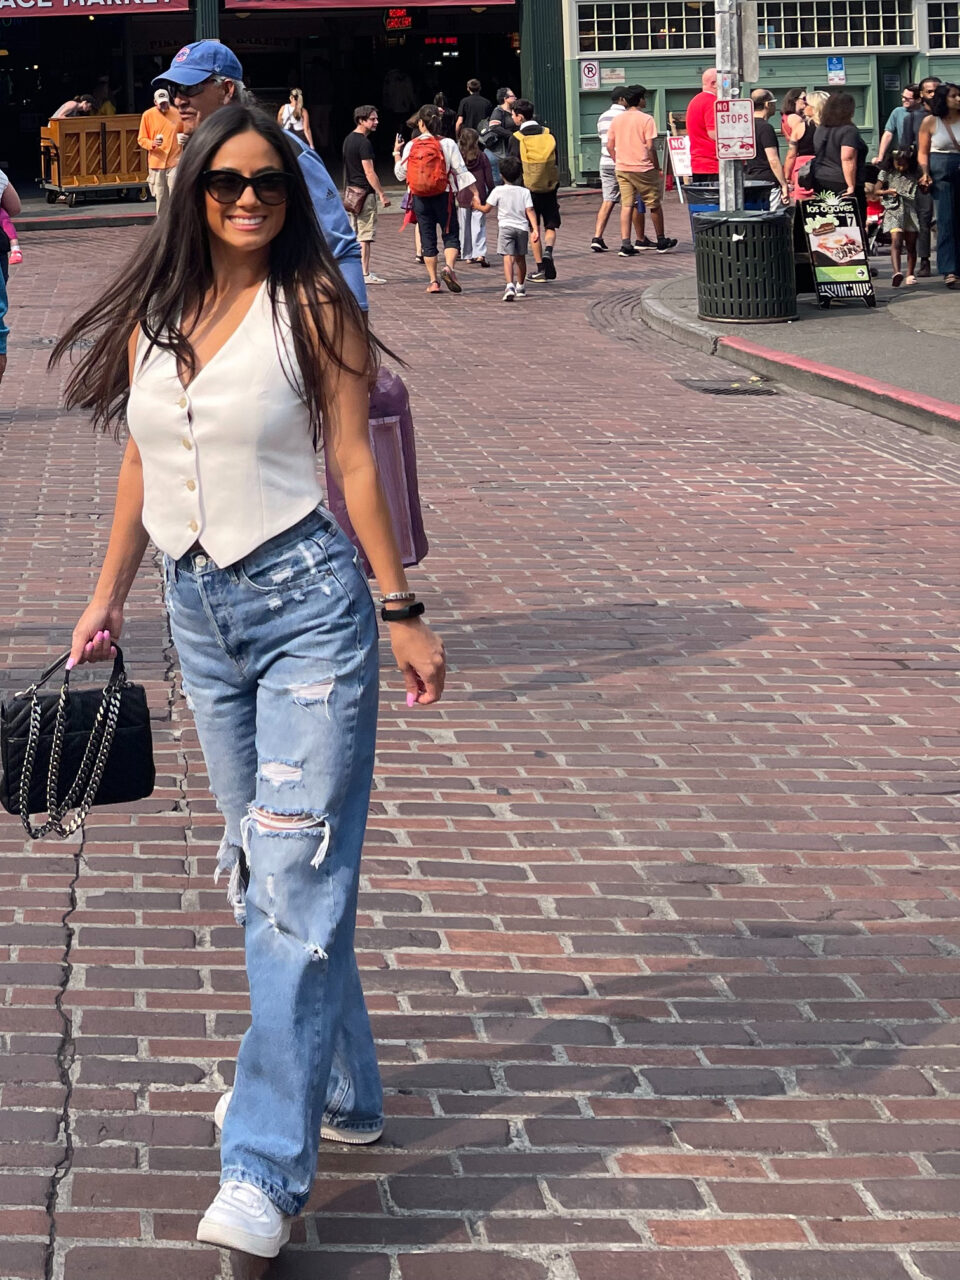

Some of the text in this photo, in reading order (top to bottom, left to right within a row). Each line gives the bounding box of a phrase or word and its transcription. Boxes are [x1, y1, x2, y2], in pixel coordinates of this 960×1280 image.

[717, 103, 728, 111] NO
[720, 114, 749, 124] STOPS
[671, 140, 685, 149] NO
